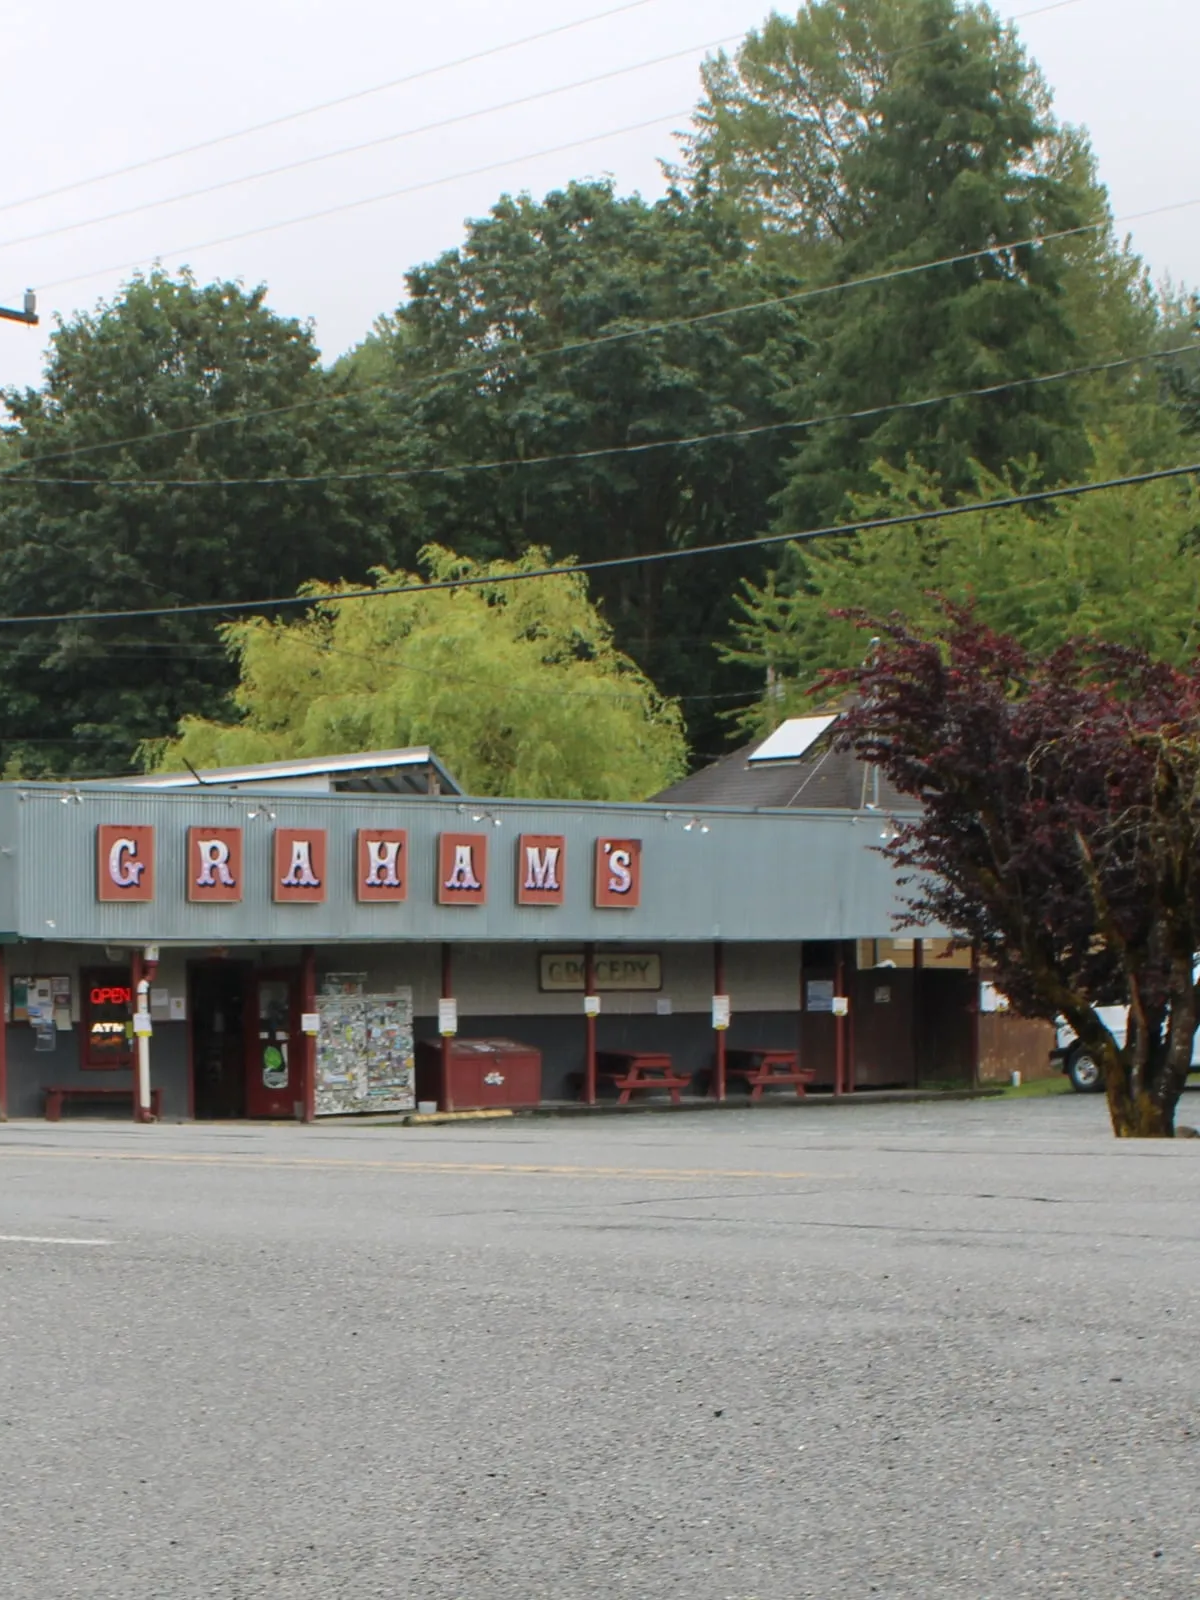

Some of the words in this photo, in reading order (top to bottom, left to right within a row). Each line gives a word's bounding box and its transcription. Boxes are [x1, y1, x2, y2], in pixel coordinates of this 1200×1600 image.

[107, 837, 633, 894] GRAHAM'S
[548, 961, 650, 982] GRCERY
[90, 987, 132, 1004] OPEN
